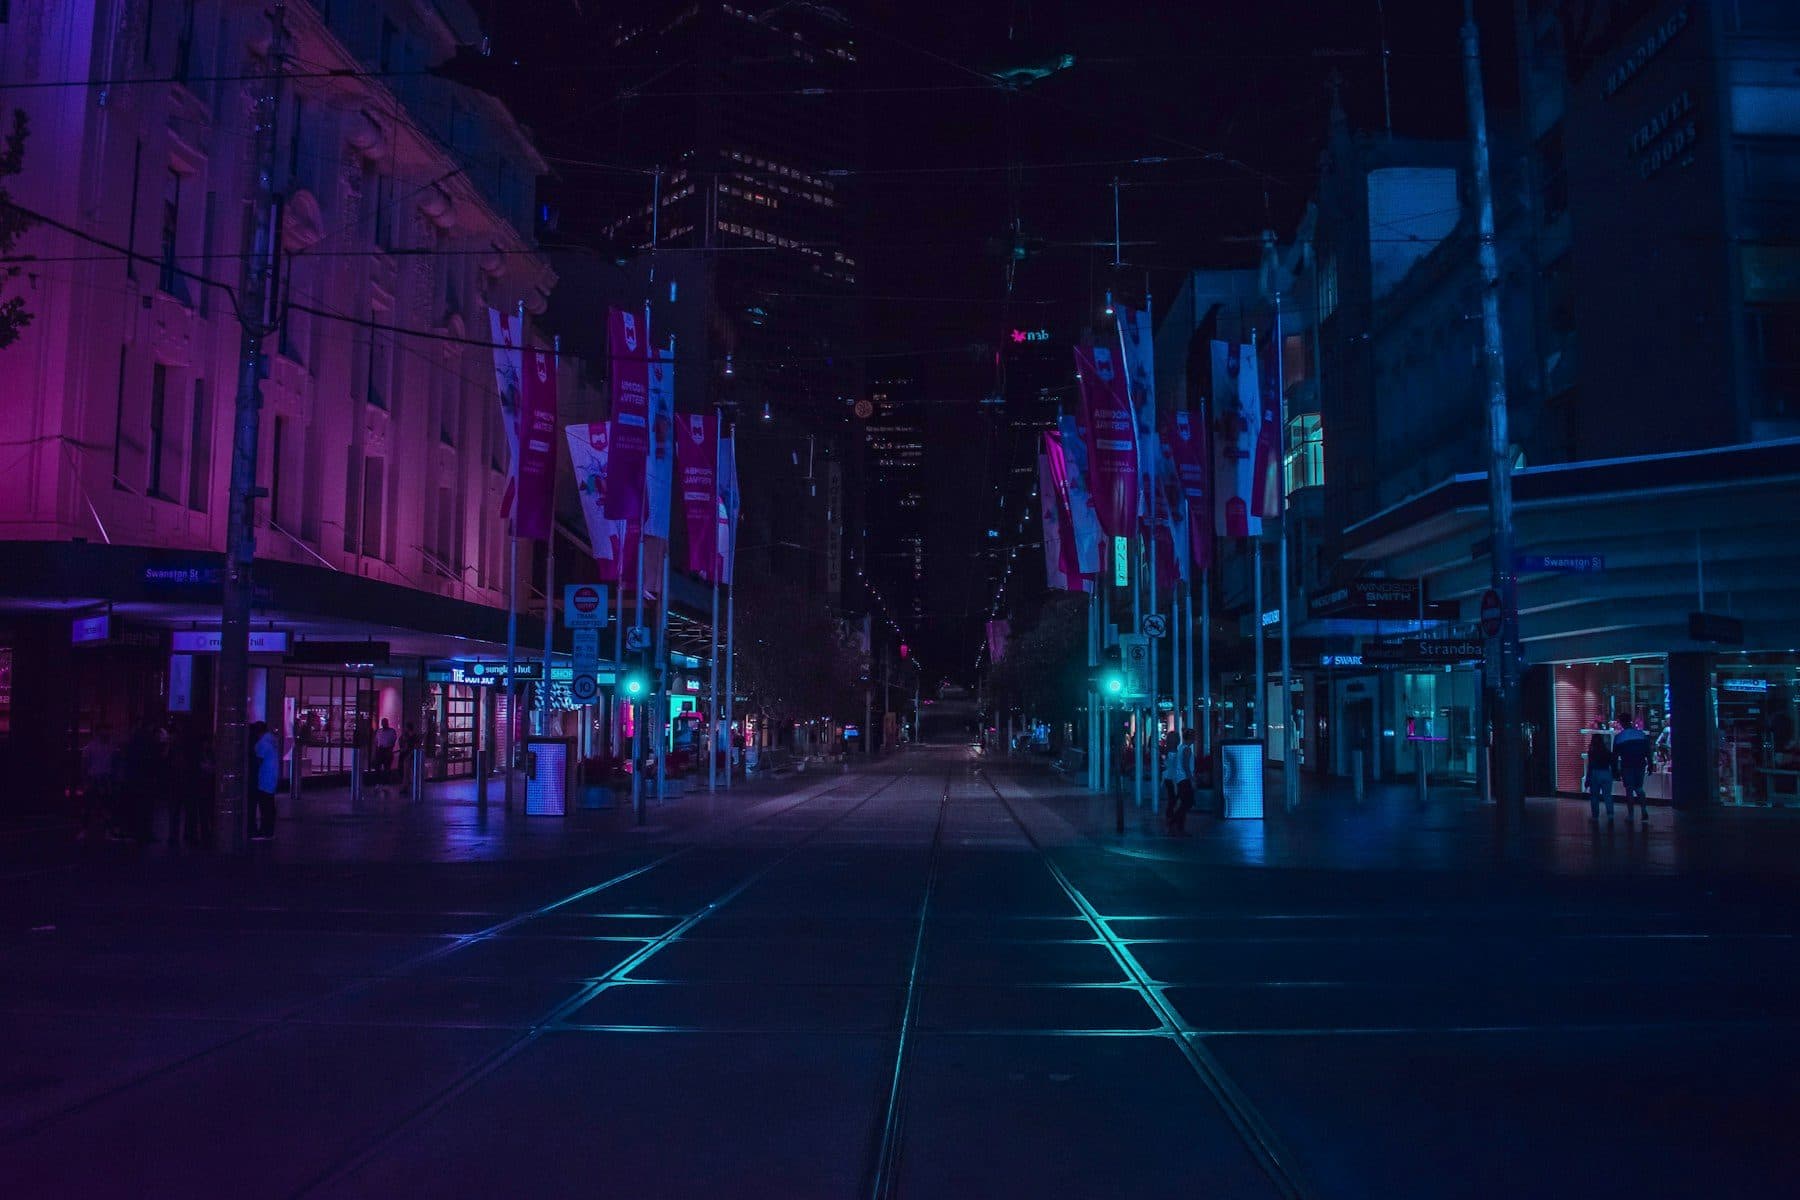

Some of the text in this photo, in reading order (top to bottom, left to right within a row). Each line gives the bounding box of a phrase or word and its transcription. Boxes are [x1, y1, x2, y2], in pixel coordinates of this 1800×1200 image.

[1598, 8, 1690, 102] HANDBAGS
[1628, 89, 1691, 153] TRAVEL
[1639, 120, 1697, 181] GOODS
[1026, 329, 1049, 341] nab
[1544, 557, 1591, 568] Swanston
[145, 568, 199, 579] Swanston St
[1366, 592, 1411, 601] SMITH
[1419, 641, 1485, 656] Strandba
[453, 668, 465, 683] THE
[518, 665, 532, 674] hut
[579, 681, 591, 693] 10
